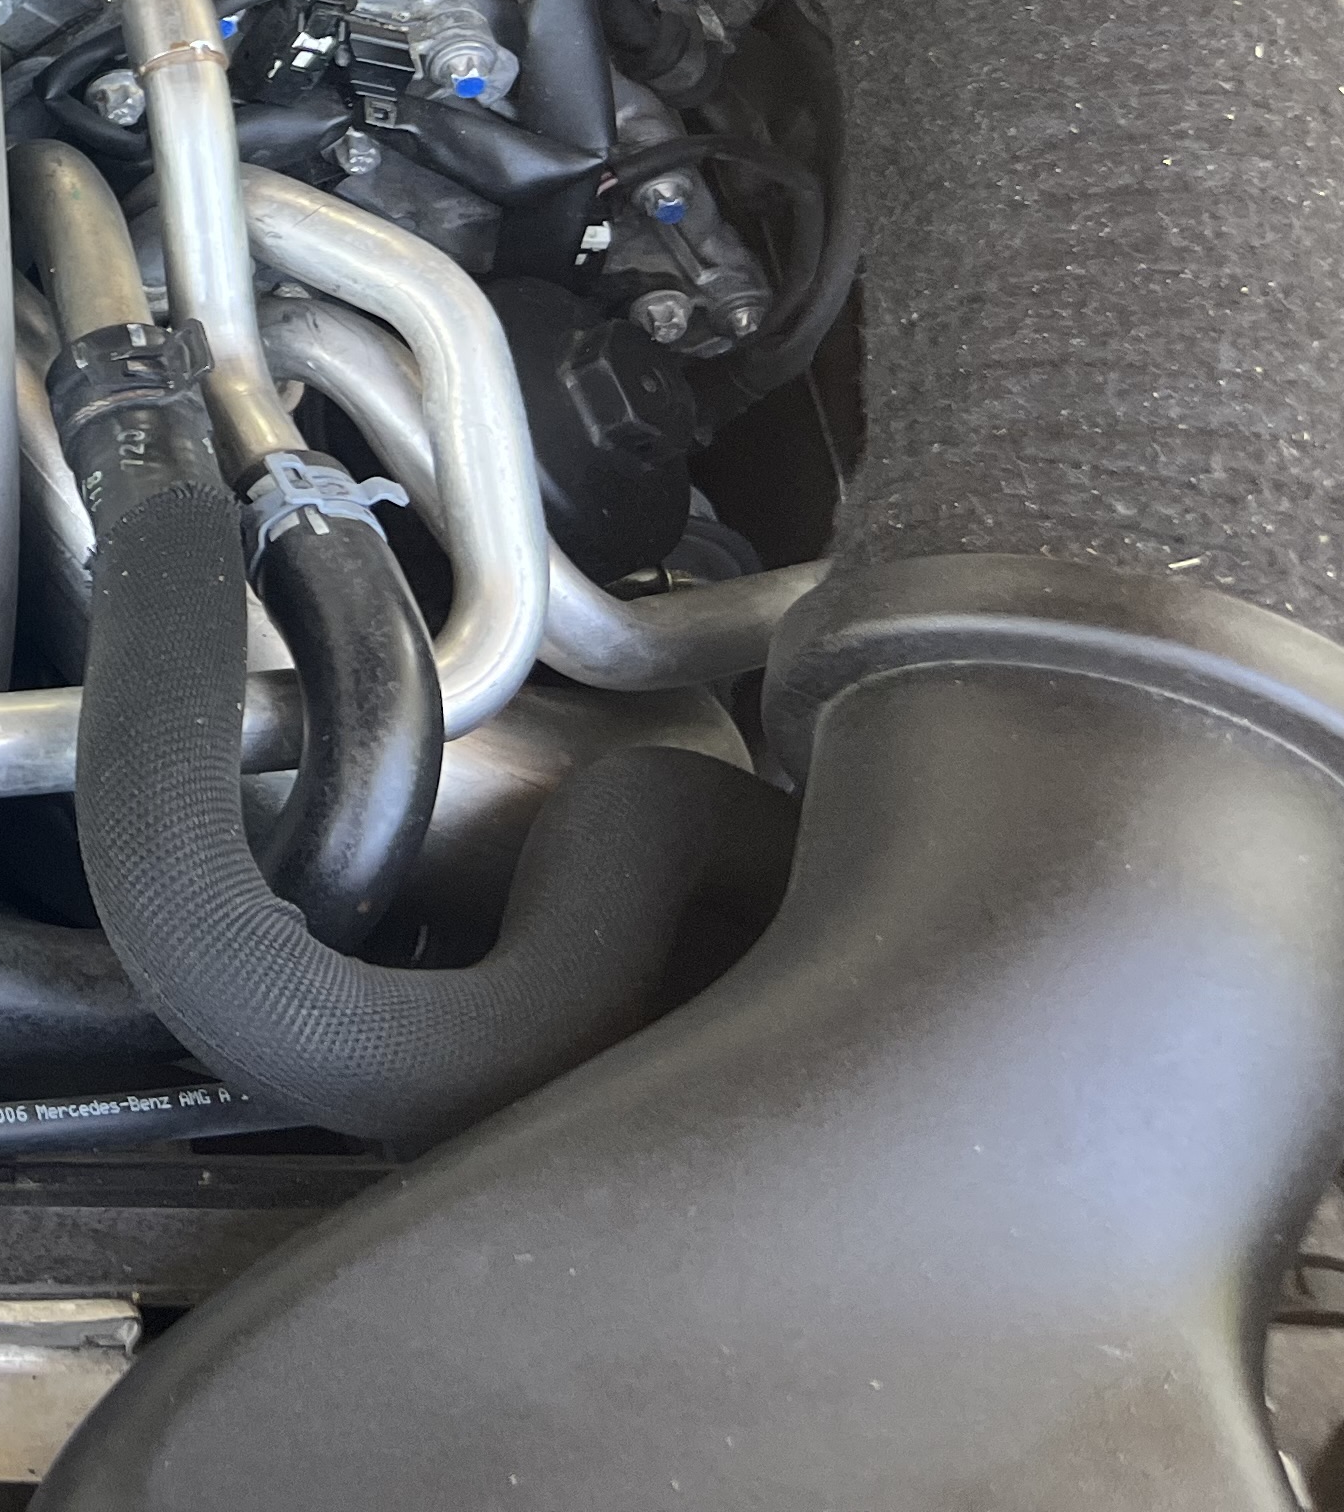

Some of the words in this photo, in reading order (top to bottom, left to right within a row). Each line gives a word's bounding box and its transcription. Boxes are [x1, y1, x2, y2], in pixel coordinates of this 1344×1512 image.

[34, 1094, 172, 1122] Mercedes-Benz
[179, 1088, 211, 1108] AMG
[218, 1087, 232, 1103] A
